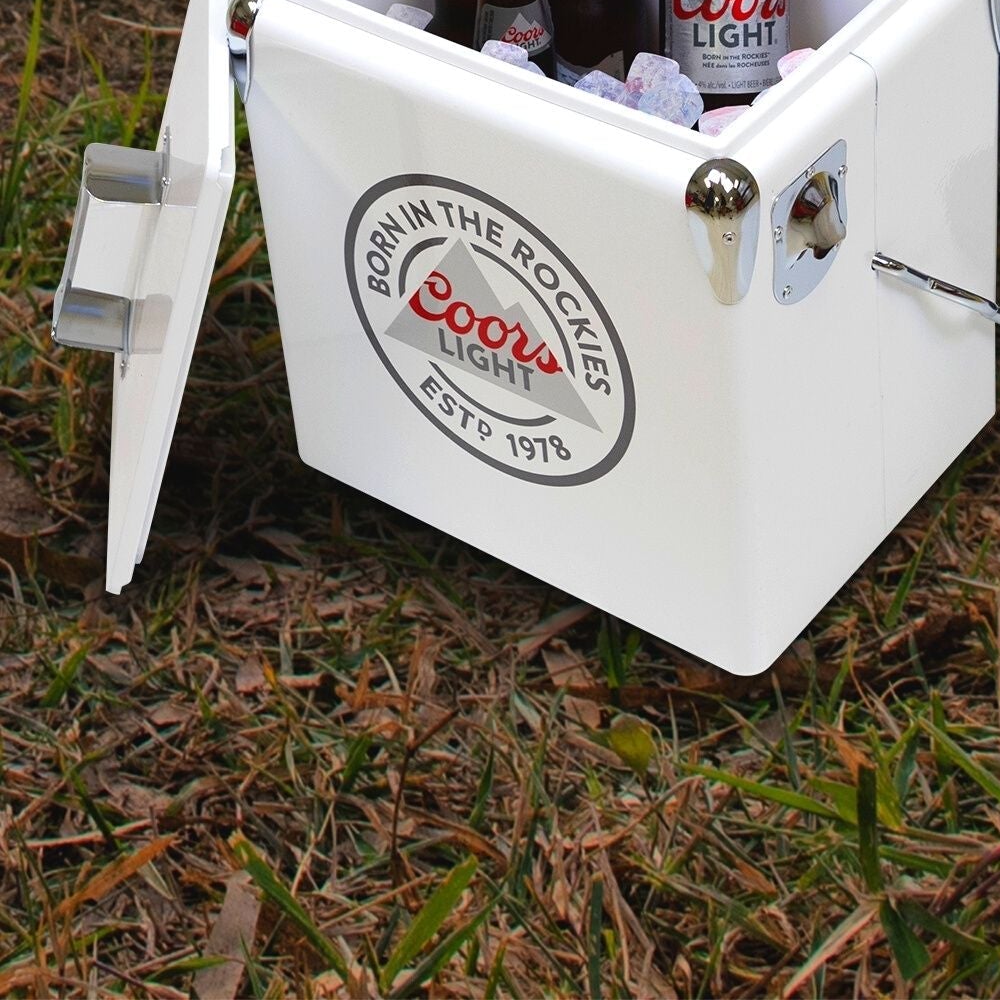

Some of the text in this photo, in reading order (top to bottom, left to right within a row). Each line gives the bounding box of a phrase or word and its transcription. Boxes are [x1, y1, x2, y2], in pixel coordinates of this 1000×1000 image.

[692, 21, 776, 49] LIGHT
[737, 60, 770, 68] ROCHEUSES
[742, 52, 769, 60] ROCKIES
[366, 199, 612, 396] BORN IN THE ROCKIES
[408, 270, 564, 375] Coors
[437, 327, 535, 392] LIGHT
[505, 434, 572, 464] 1978
